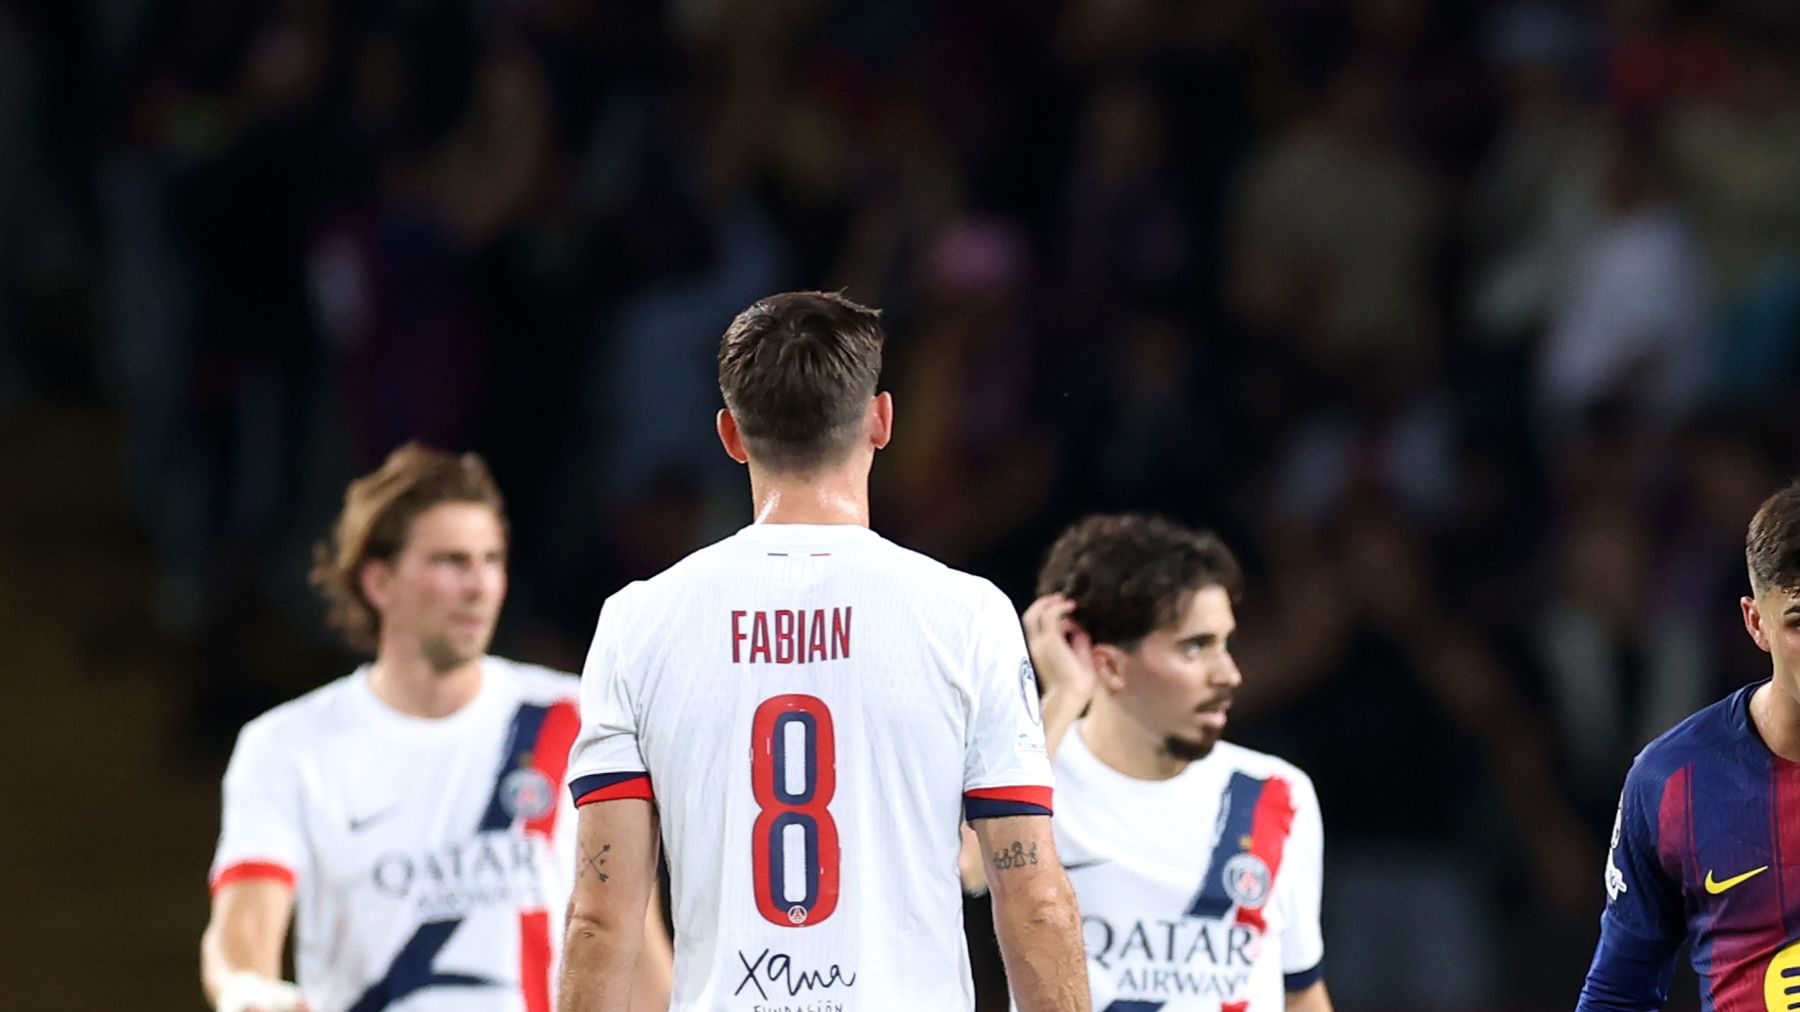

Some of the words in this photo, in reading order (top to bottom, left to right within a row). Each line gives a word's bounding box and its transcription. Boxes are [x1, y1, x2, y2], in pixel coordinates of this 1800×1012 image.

[731, 606, 852, 664] FABIAN
[751, 693, 840, 928] 8
[1081, 915, 1252, 970] QATAR
[734, 947, 856, 1001] Xana
